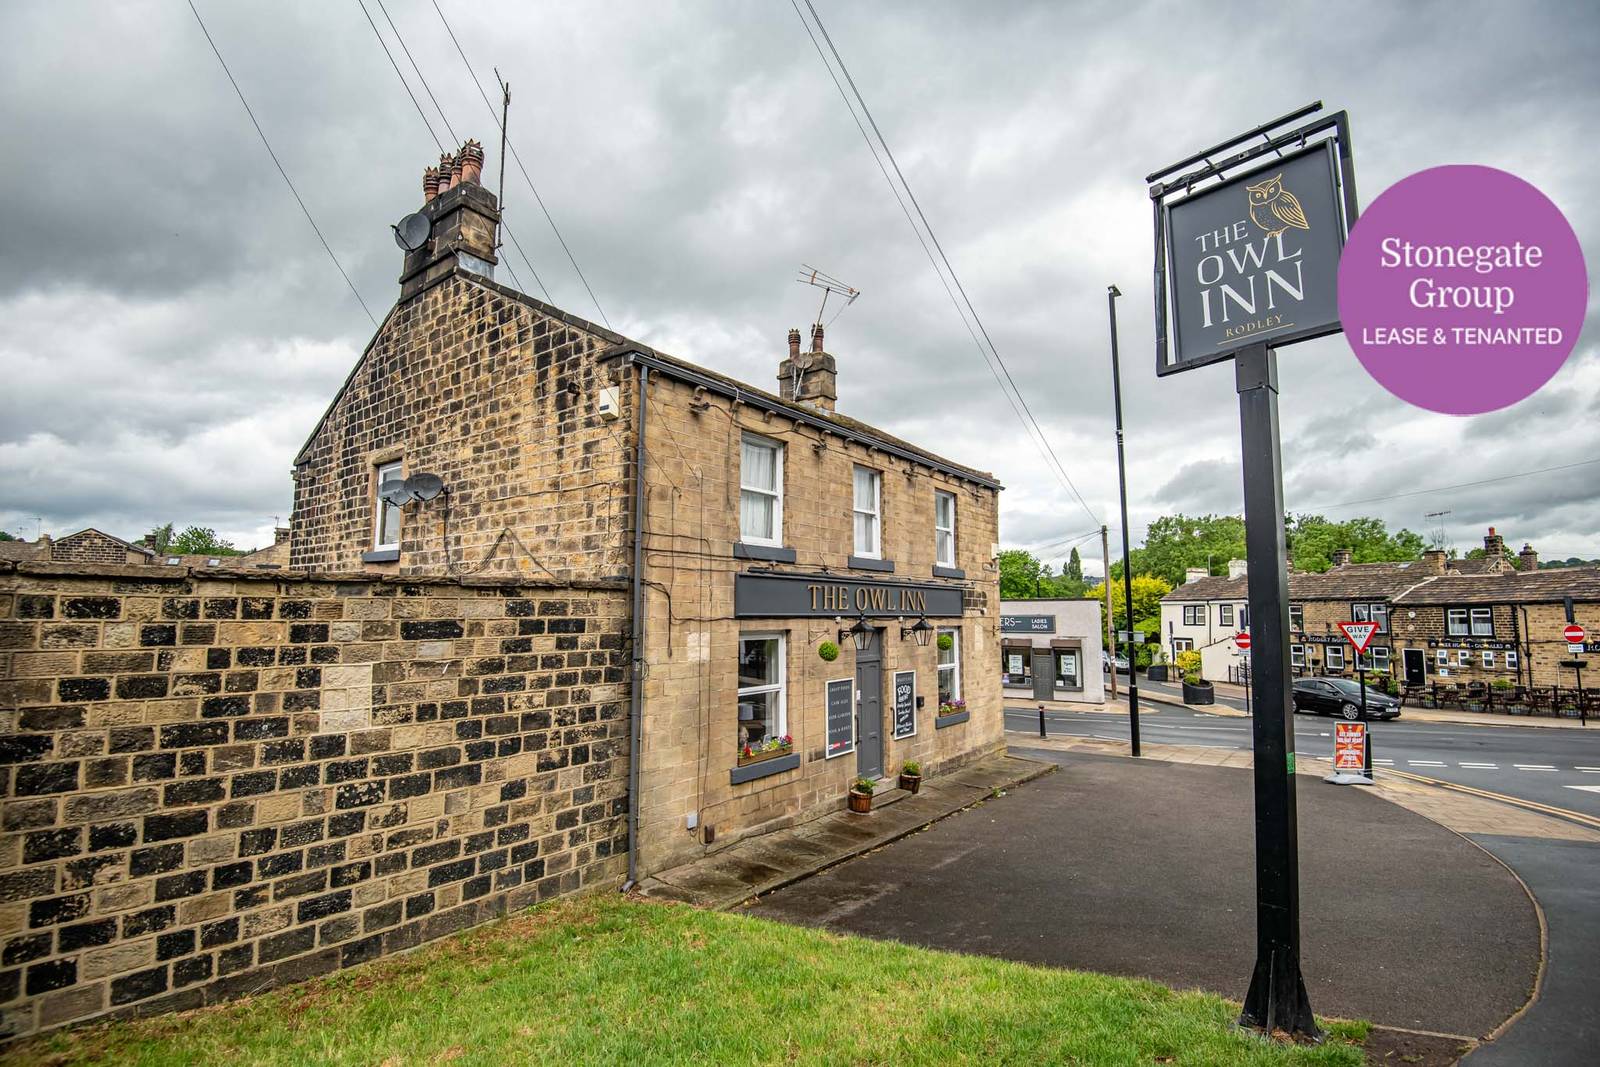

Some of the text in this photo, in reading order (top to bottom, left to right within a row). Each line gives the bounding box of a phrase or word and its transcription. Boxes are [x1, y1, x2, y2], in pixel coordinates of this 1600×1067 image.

[1195, 220, 1249, 253] THE
[1197, 231, 1303, 285] OWL
[1200, 260, 1304, 328] INN
[1226, 315, 1283, 337] RODLEY
[807, 584, 926, 611] THE OWL INN
